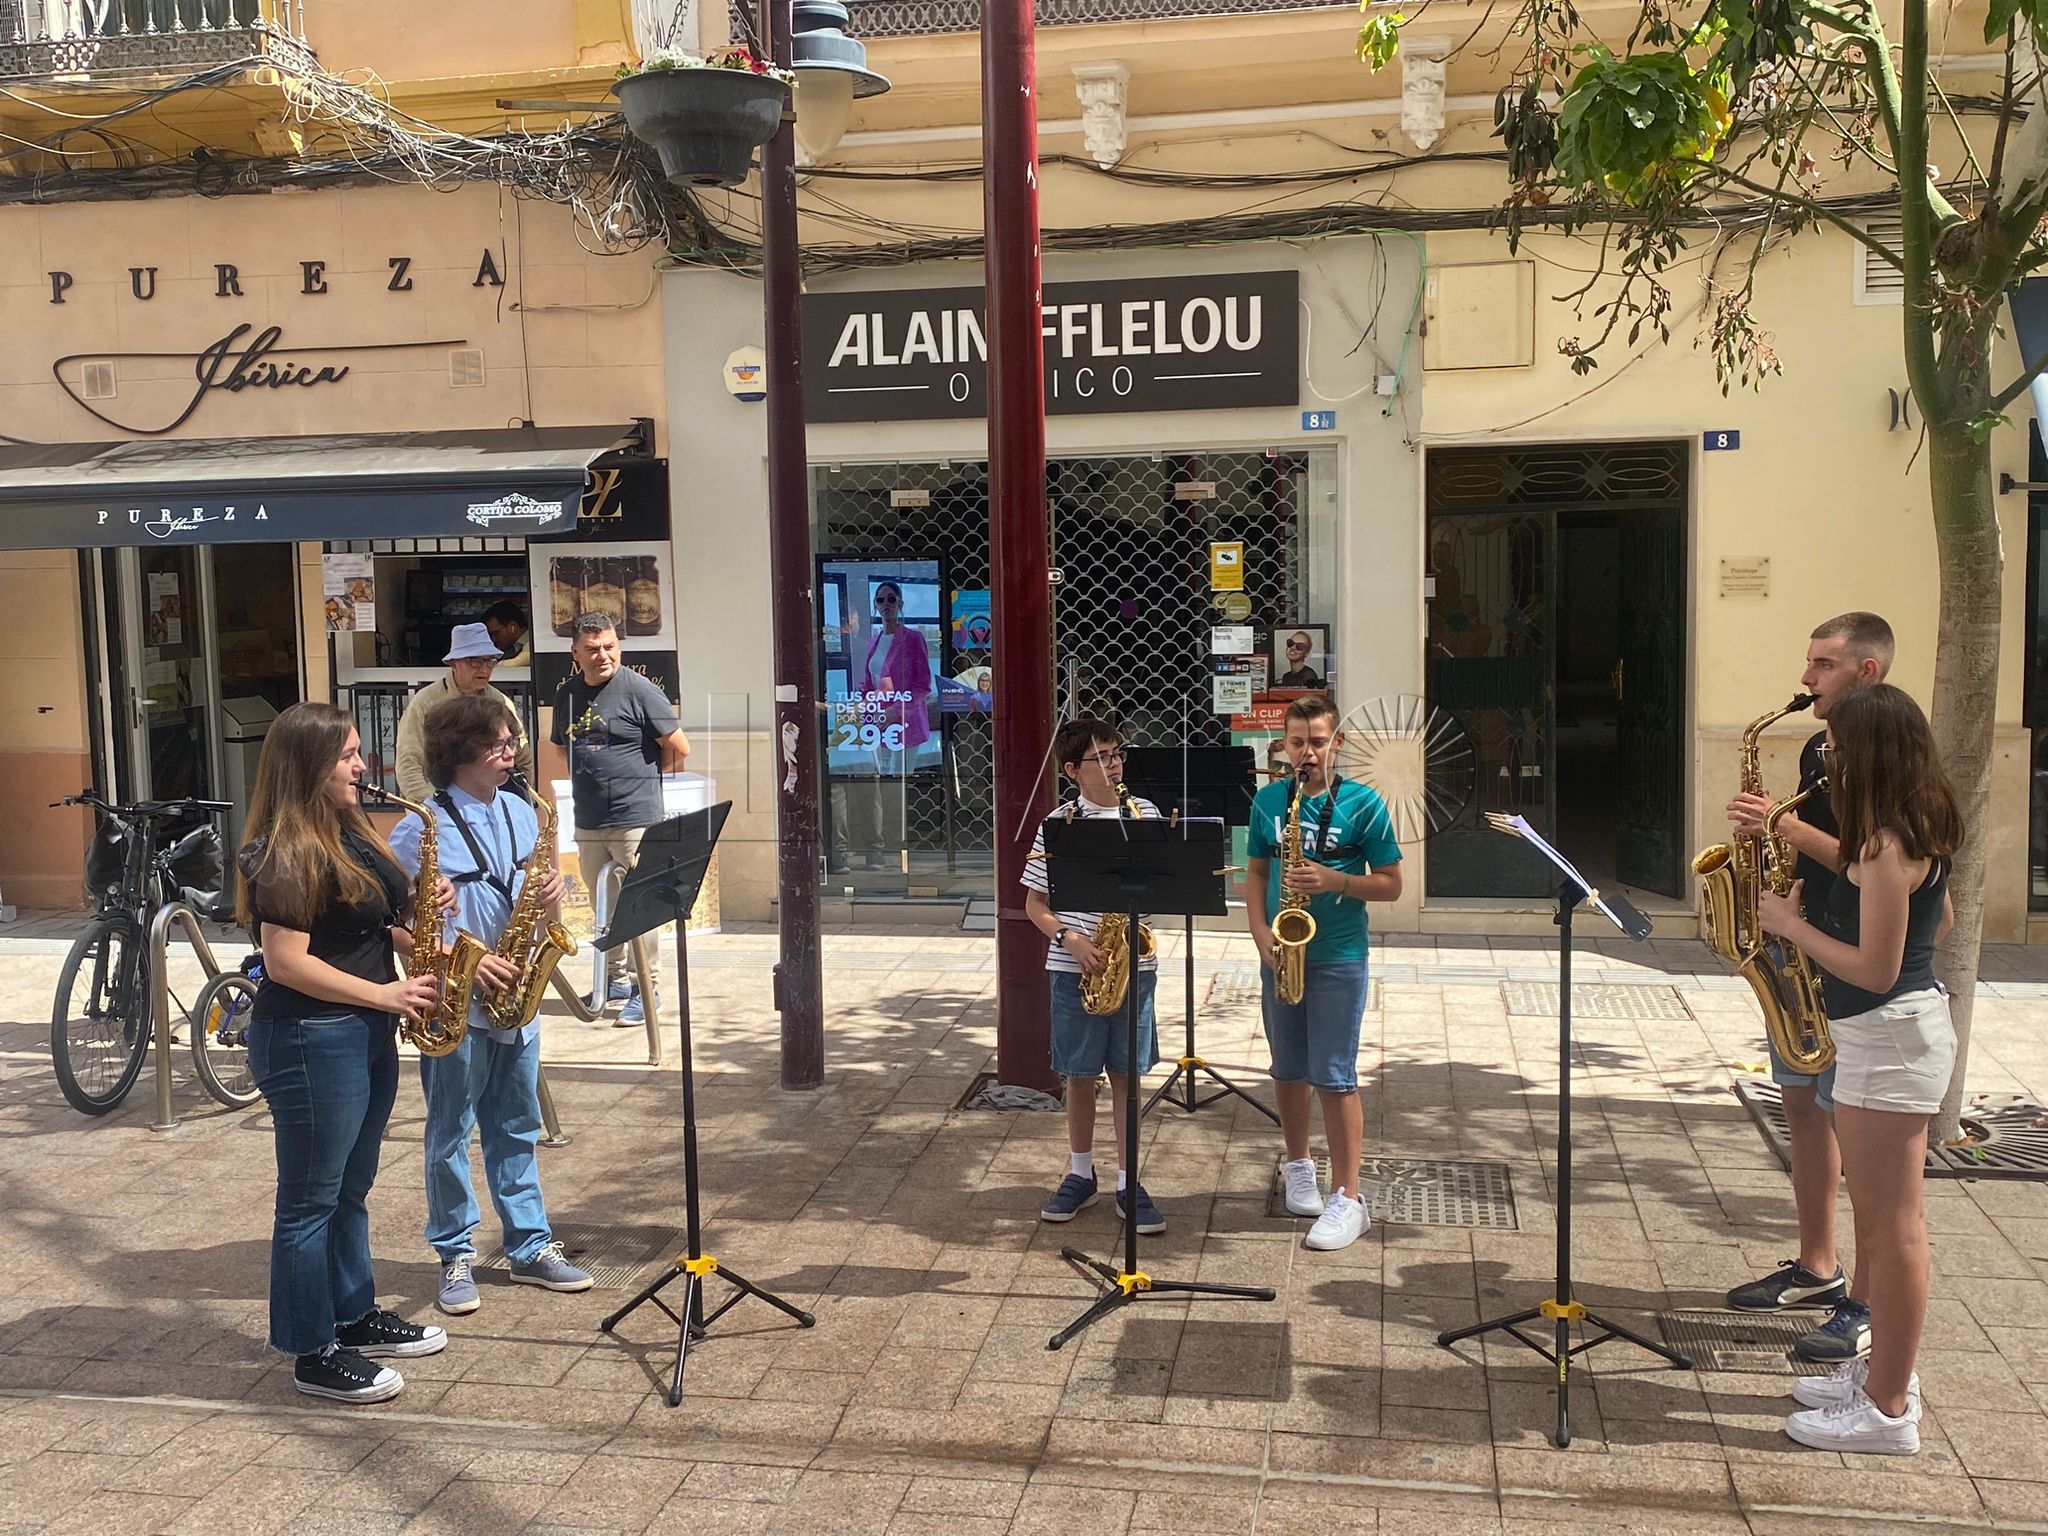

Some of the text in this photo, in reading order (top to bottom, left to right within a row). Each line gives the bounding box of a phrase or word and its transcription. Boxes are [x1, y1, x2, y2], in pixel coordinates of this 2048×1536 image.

[48, 248, 504, 303] PUREZA
[827, 295, 1262, 366] ALAIN FFLELOU
[949, 365, 1134, 402] OICO
[1310, 414, 1318, 428] 8
[1718, 434, 1728, 448] 8
[97, 504, 268, 525] PUREZA
[467, 503, 562, 516] CORTIJO COLOMO
[836, 690, 912, 702] TUS GAFAS
[836, 702, 886, 713] DE SOL
[1260, 708, 1282, 718] CLIP
[836, 714, 886, 724] POR SOLO
